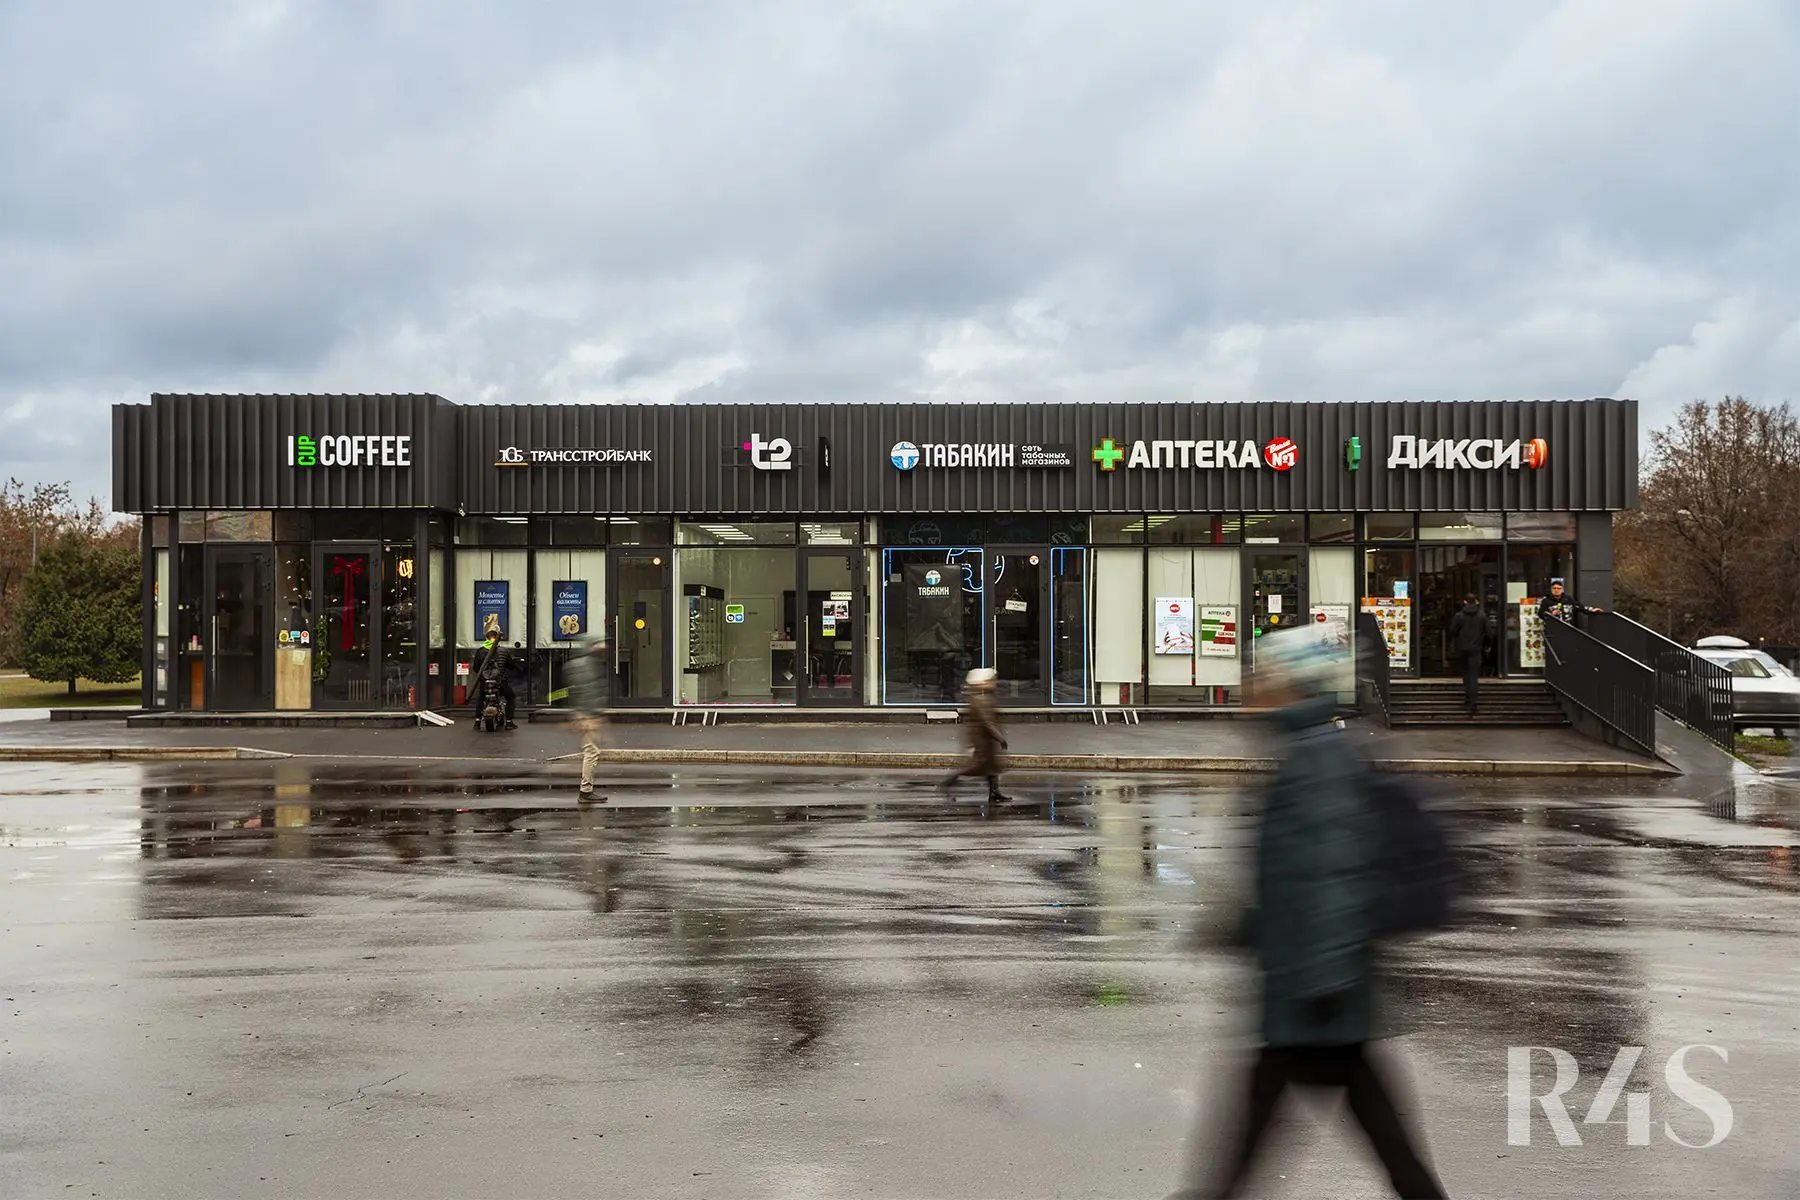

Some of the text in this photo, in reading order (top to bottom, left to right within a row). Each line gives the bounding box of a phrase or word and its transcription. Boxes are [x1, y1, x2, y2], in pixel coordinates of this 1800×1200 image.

[287, 434, 411, 467] I CUP COFFEE
[530, 449, 652, 462] ТРАНССТРОЙБАНК
[922, 443, 1014, 467] ТАБАКИН
[1021, 451, 1066, 459] табачных
[1127, 440, 1261, 468] АПТЕКА
[1387, 435, 1520, 469] ДИКСИ
[918, 586, 950, 596] ТАБАКИН
